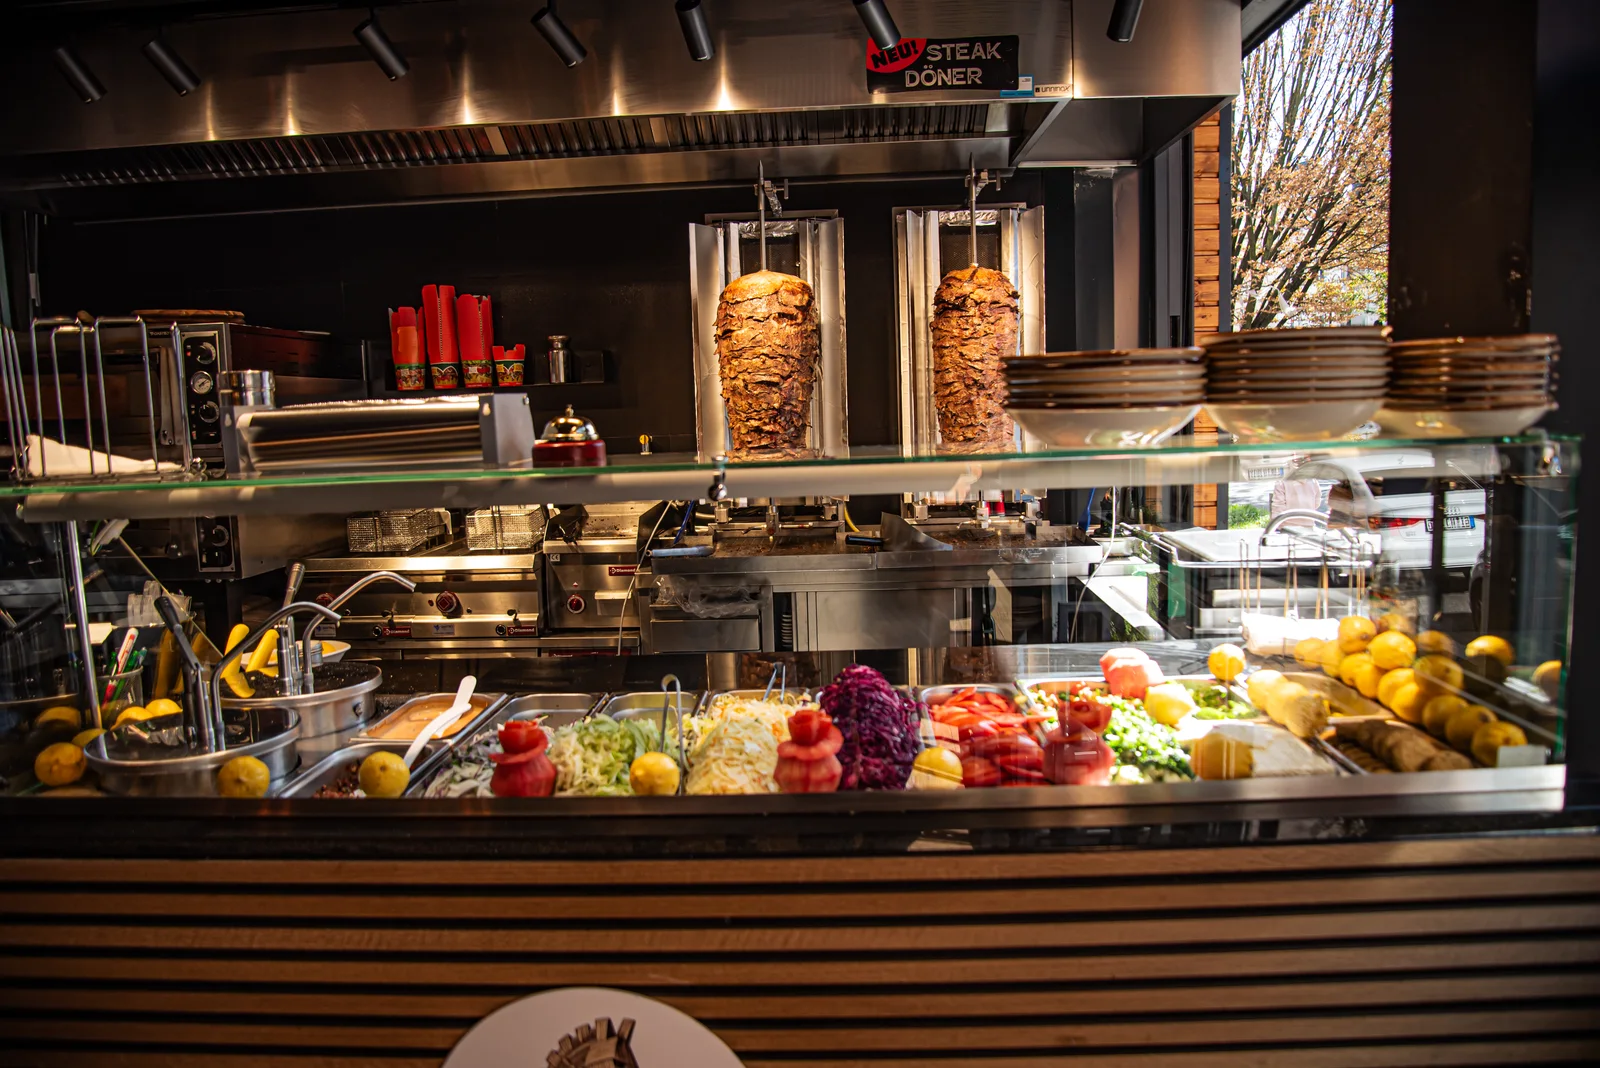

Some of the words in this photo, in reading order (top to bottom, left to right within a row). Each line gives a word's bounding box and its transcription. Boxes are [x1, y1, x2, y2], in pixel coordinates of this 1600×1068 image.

[870, 39, 918, 68] NEU!
[926, 41, 1001, 61] STEAK
[905, 65, 982, 87] DÖNER
